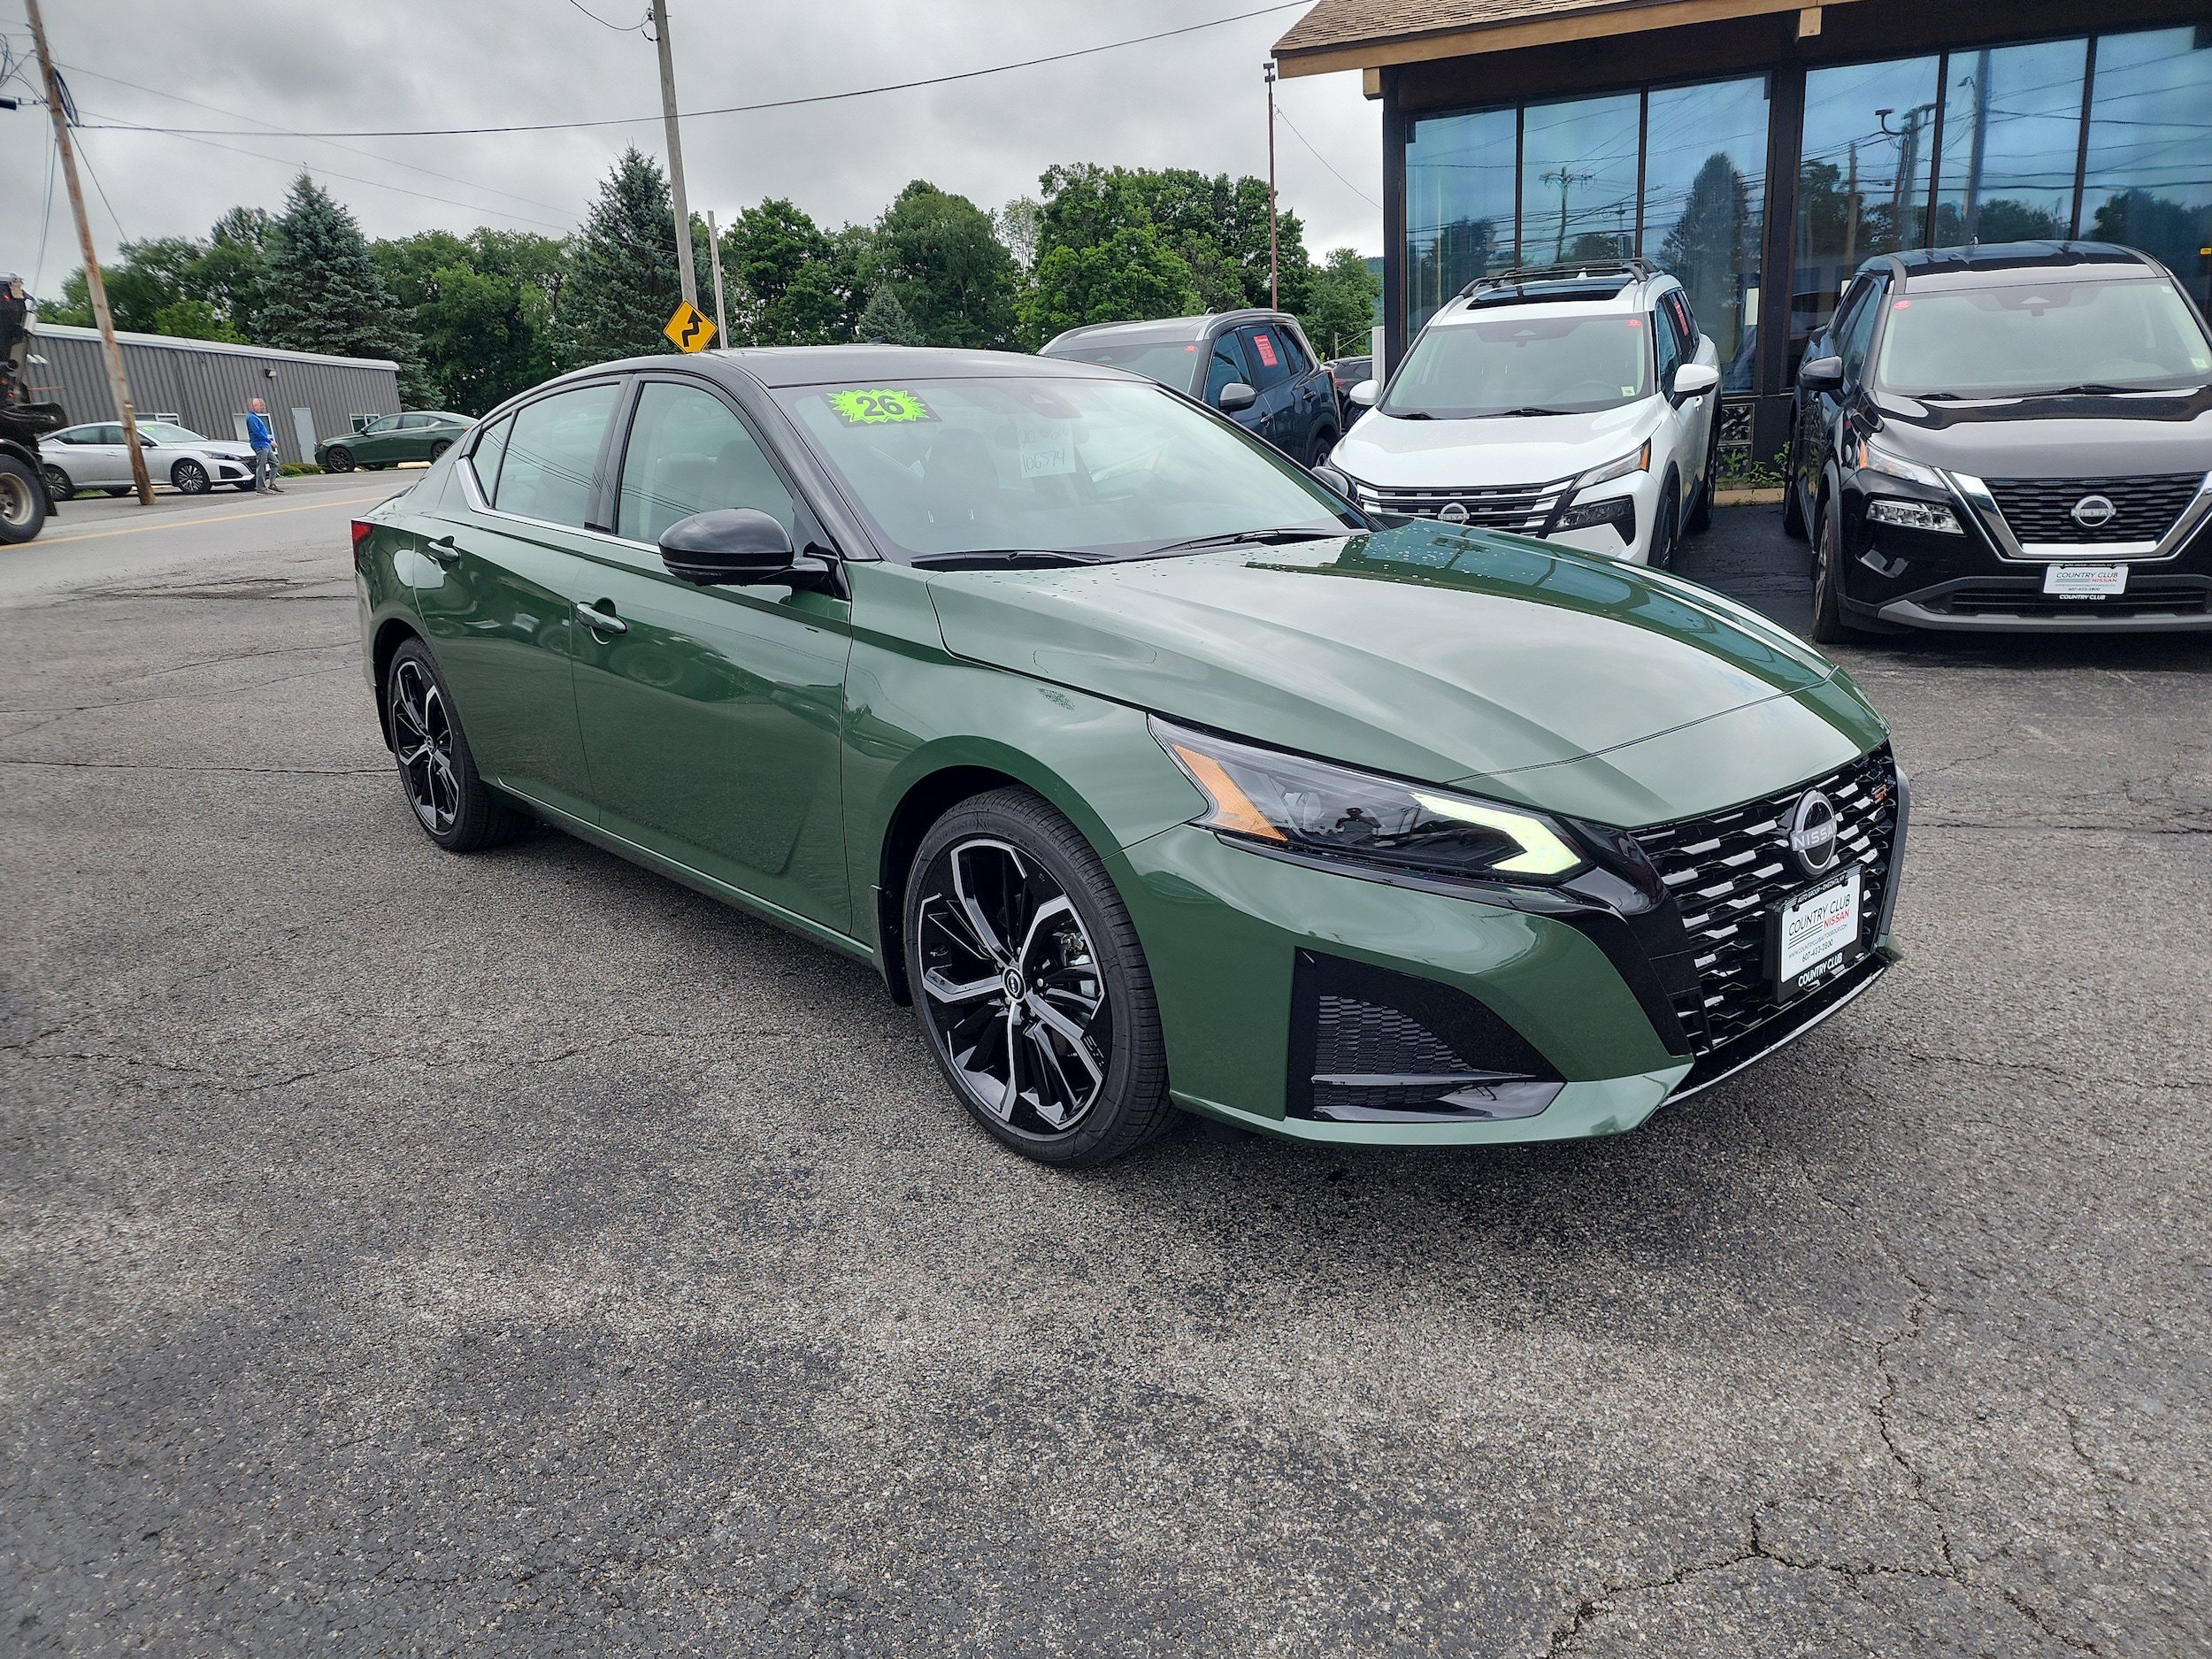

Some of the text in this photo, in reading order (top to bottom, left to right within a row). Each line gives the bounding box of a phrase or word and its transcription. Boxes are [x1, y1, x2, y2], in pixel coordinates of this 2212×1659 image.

[856, 395, 905, 417] 26
[1022, 448, 1065, 473] 106574
[2070, 507, 2116, 517] NISSAN
[1793, 822, 1837, 849] NISSAN
[1788, 894, 1851, 936] COUNTRY CLUB
[1824, 910, 1850, 929] NISSAN
[1798, 952, 1843, 987] COUNTRY CLUB
